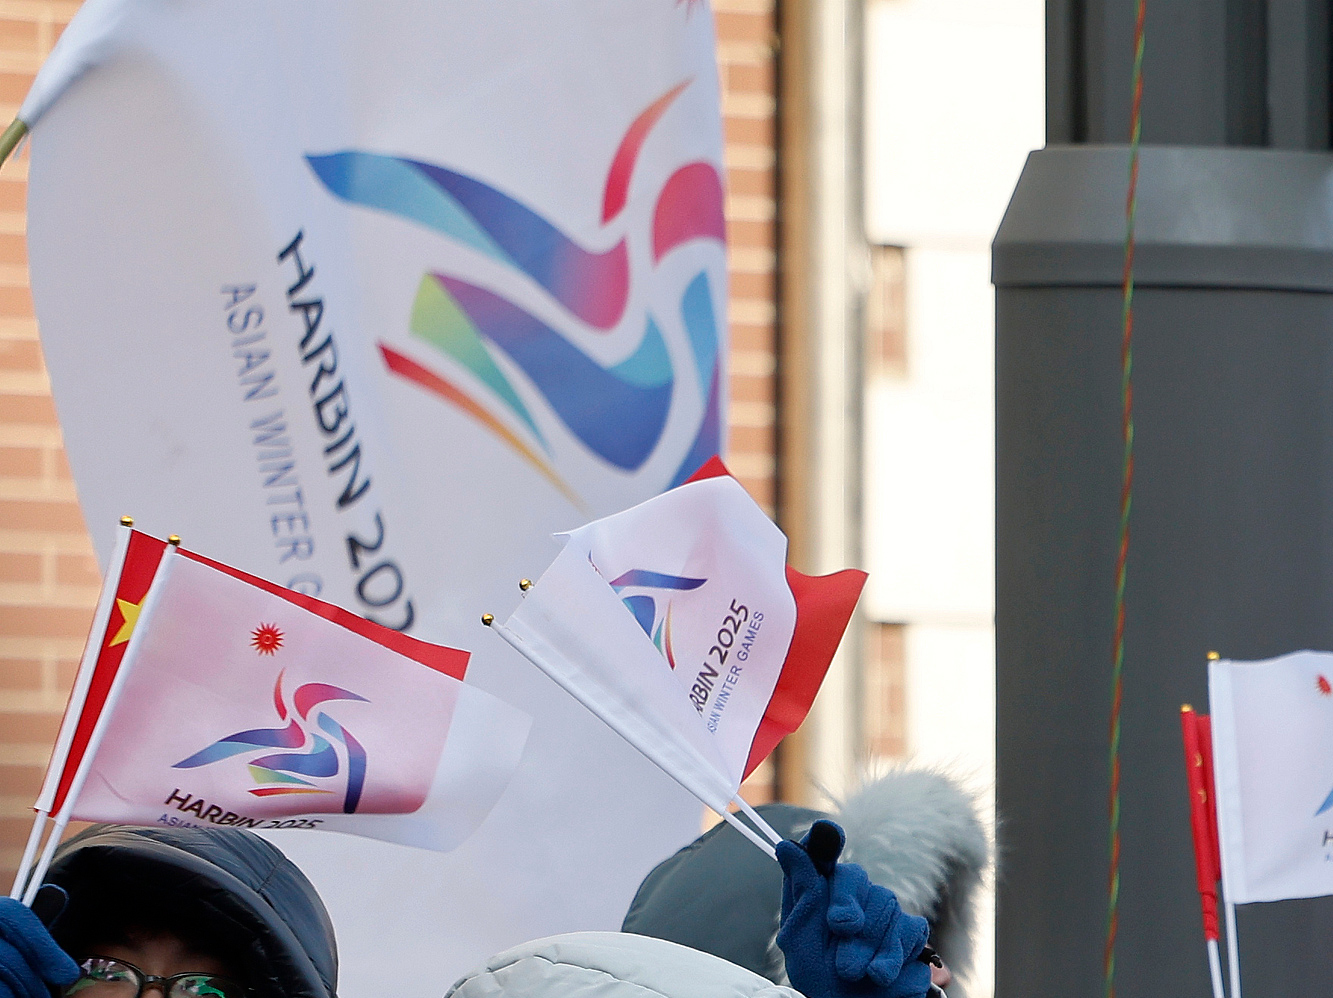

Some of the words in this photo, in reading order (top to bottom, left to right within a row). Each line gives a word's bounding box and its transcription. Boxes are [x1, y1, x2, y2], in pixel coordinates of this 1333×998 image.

[220, 282, 281, 402] ASIAN
[277, 227, 372, 510] HARBIN
[250, 411, 314, 565] WINTER
[709, 598, 749, 666] 2025
[713, 664, 743, 714] WINTER
[736, 611, 764, 662] GAMES
[164, 788, 264, 829] HARBIN
